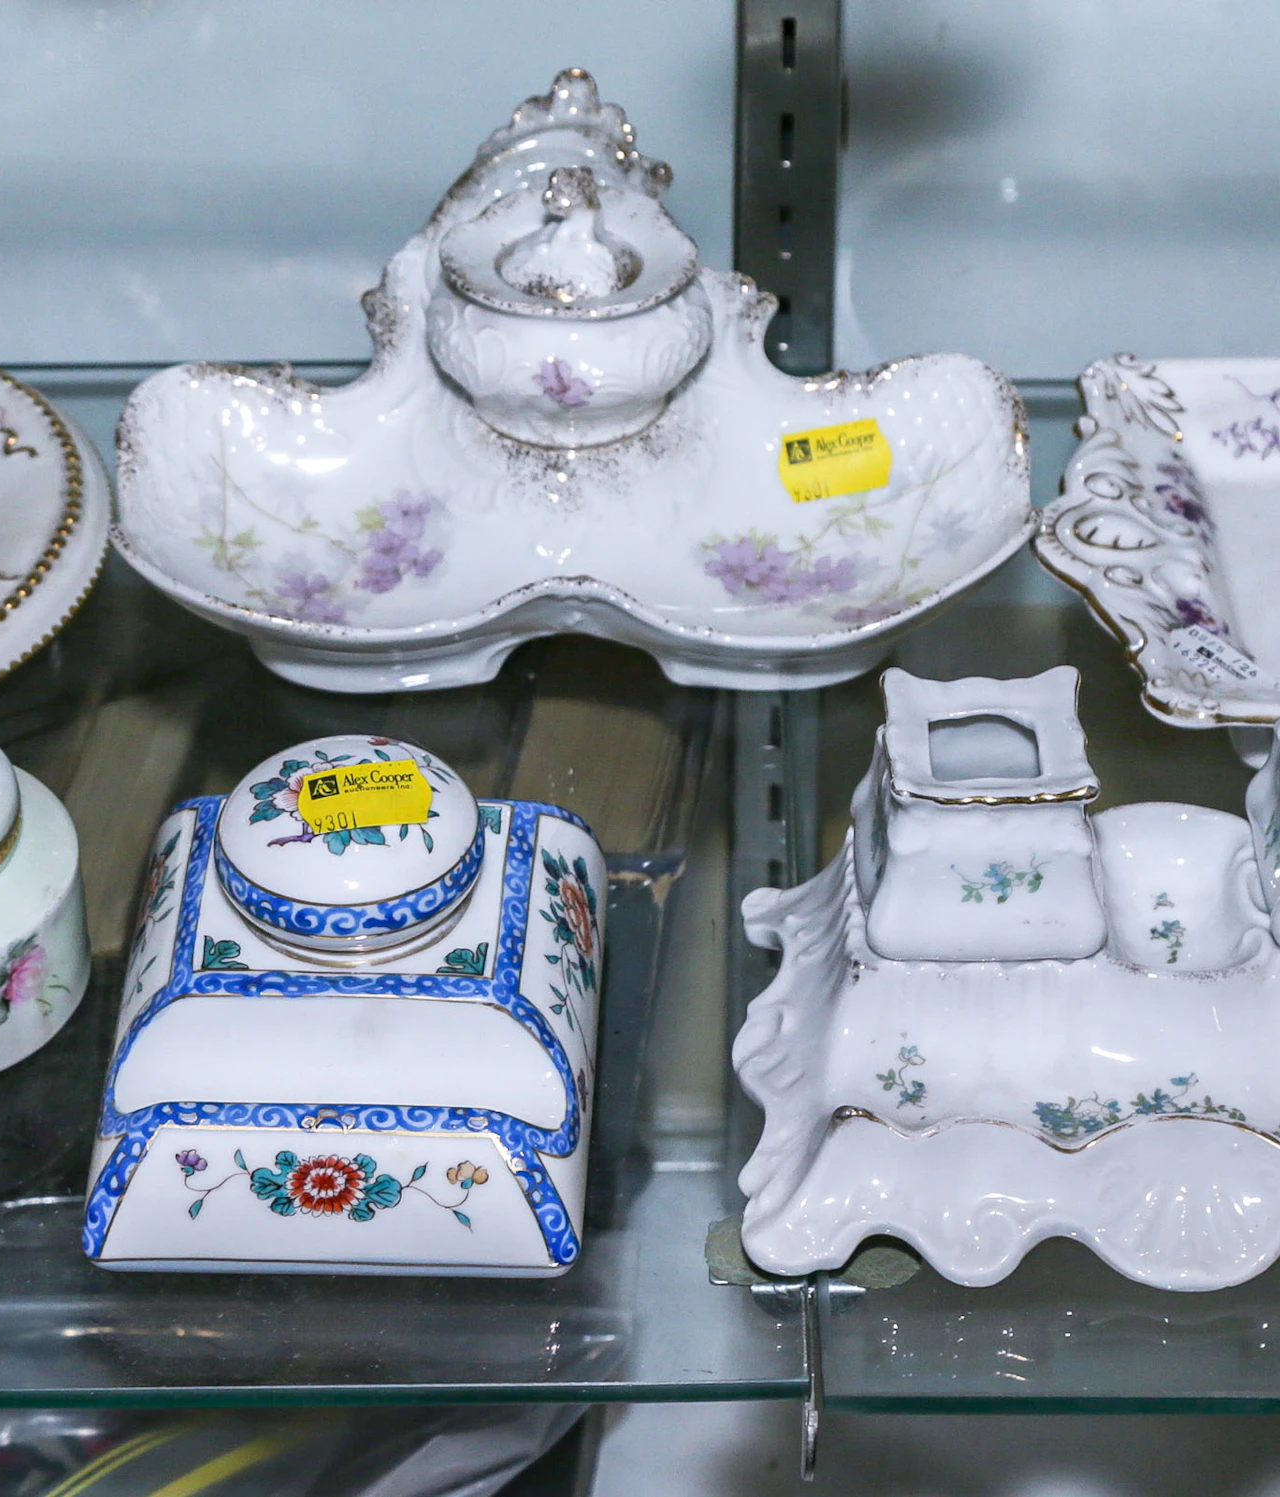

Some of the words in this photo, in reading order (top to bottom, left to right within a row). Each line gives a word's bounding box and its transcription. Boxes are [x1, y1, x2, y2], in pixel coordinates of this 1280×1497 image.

[343, 773, 369, 788] Alex
[370, 770, 414, 786] Cooper
[314, 810, 357, 833] 9301
